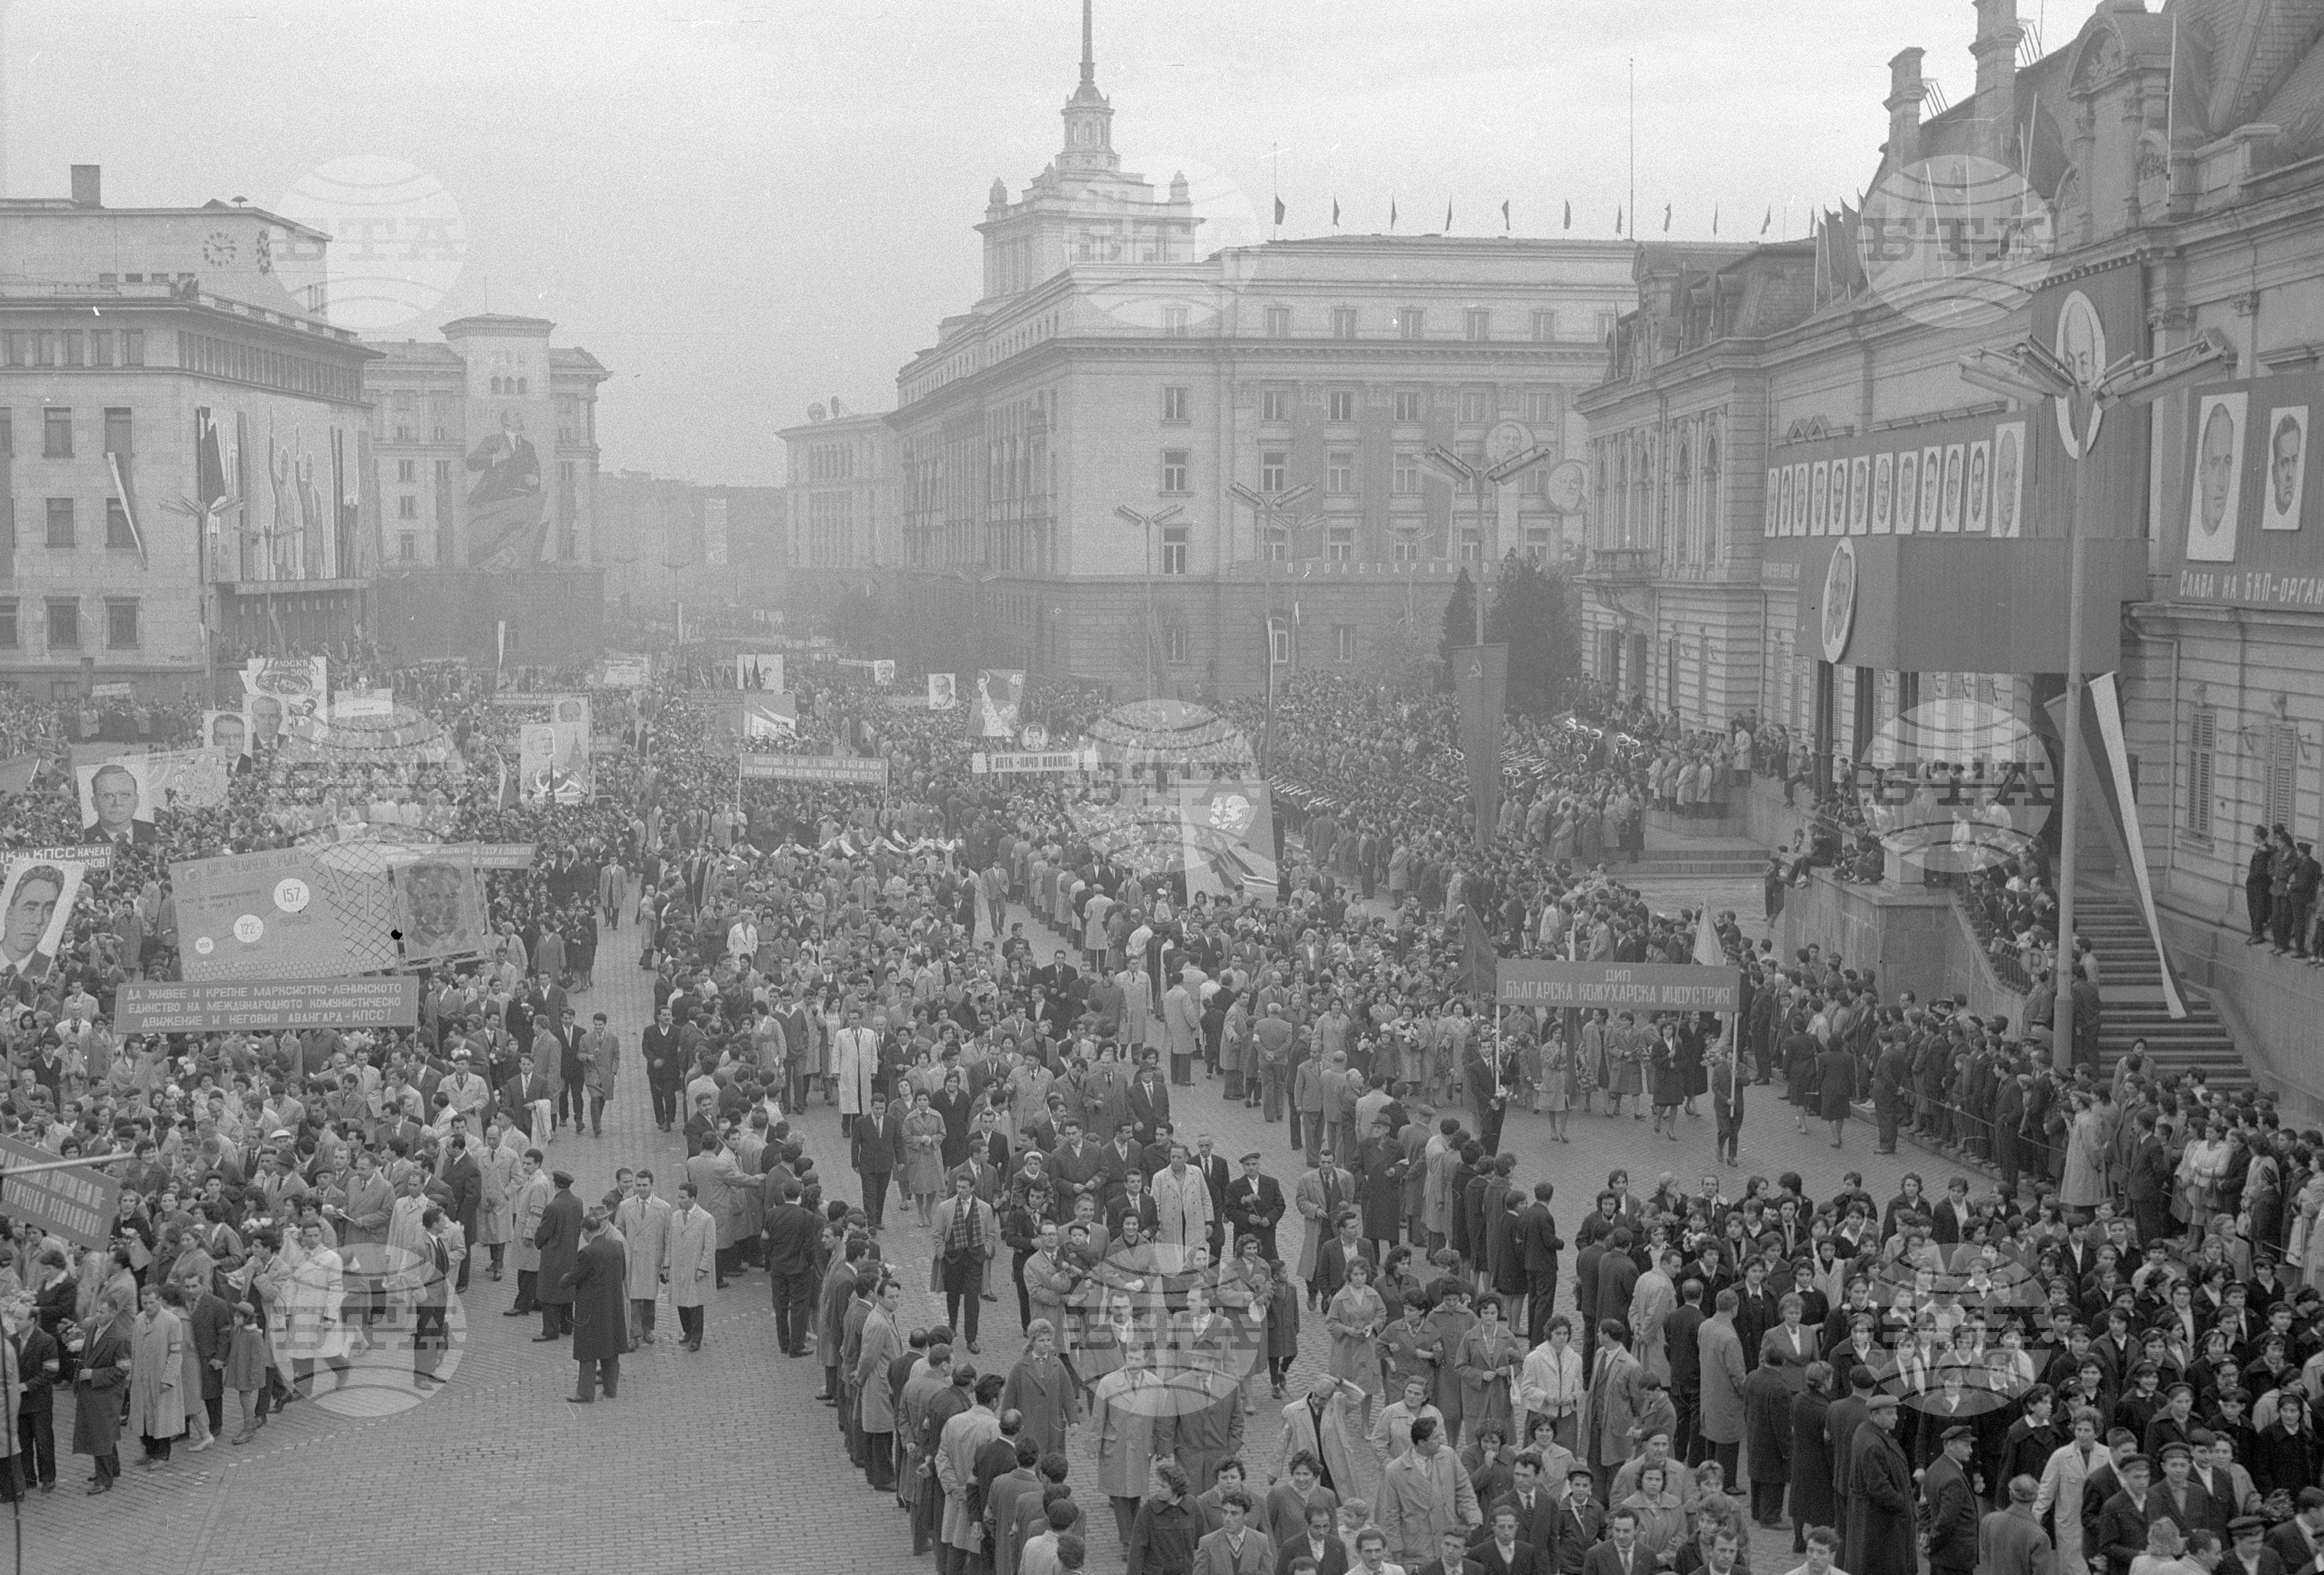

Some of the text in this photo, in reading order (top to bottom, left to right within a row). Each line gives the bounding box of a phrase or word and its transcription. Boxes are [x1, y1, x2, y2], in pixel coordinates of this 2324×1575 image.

[1287, 562, 1452, 574] ПРОЛЕТАРИИ
[2180, 570, 2214, 598] СЛАВА
[2222, 574, 2237, 600] НА
[1009, 674, 1023, 685] 46
[34, 847, 76, 860] КПСС
[78, 846, 112, 857] НАЧЕЛО
[282, 887, 301, 903] 157
[241, 922, 256, 935] 122
[1605, 969, 1631, 983] ДИП
[127, 983, 402, 1001] ДА ЖИВЕЕ И КРЕПНЕ МАРКСИСТКО-ЛЕНИНСКОТО
[1579, 983, 1656, 1003] КОЖУХАРСКА
[128, 997, 401, 1014] ЕДИНСТВО НА МЕЖДУНАРОДНОТО КОМУНИСТИЧЕСКО
[142, 1015, 203, 1028] ДВИЖЕНИЕ
[213, 1015, 220, 1025] И
[229, 1013, 278, 1024] НЕГОВИЯ
